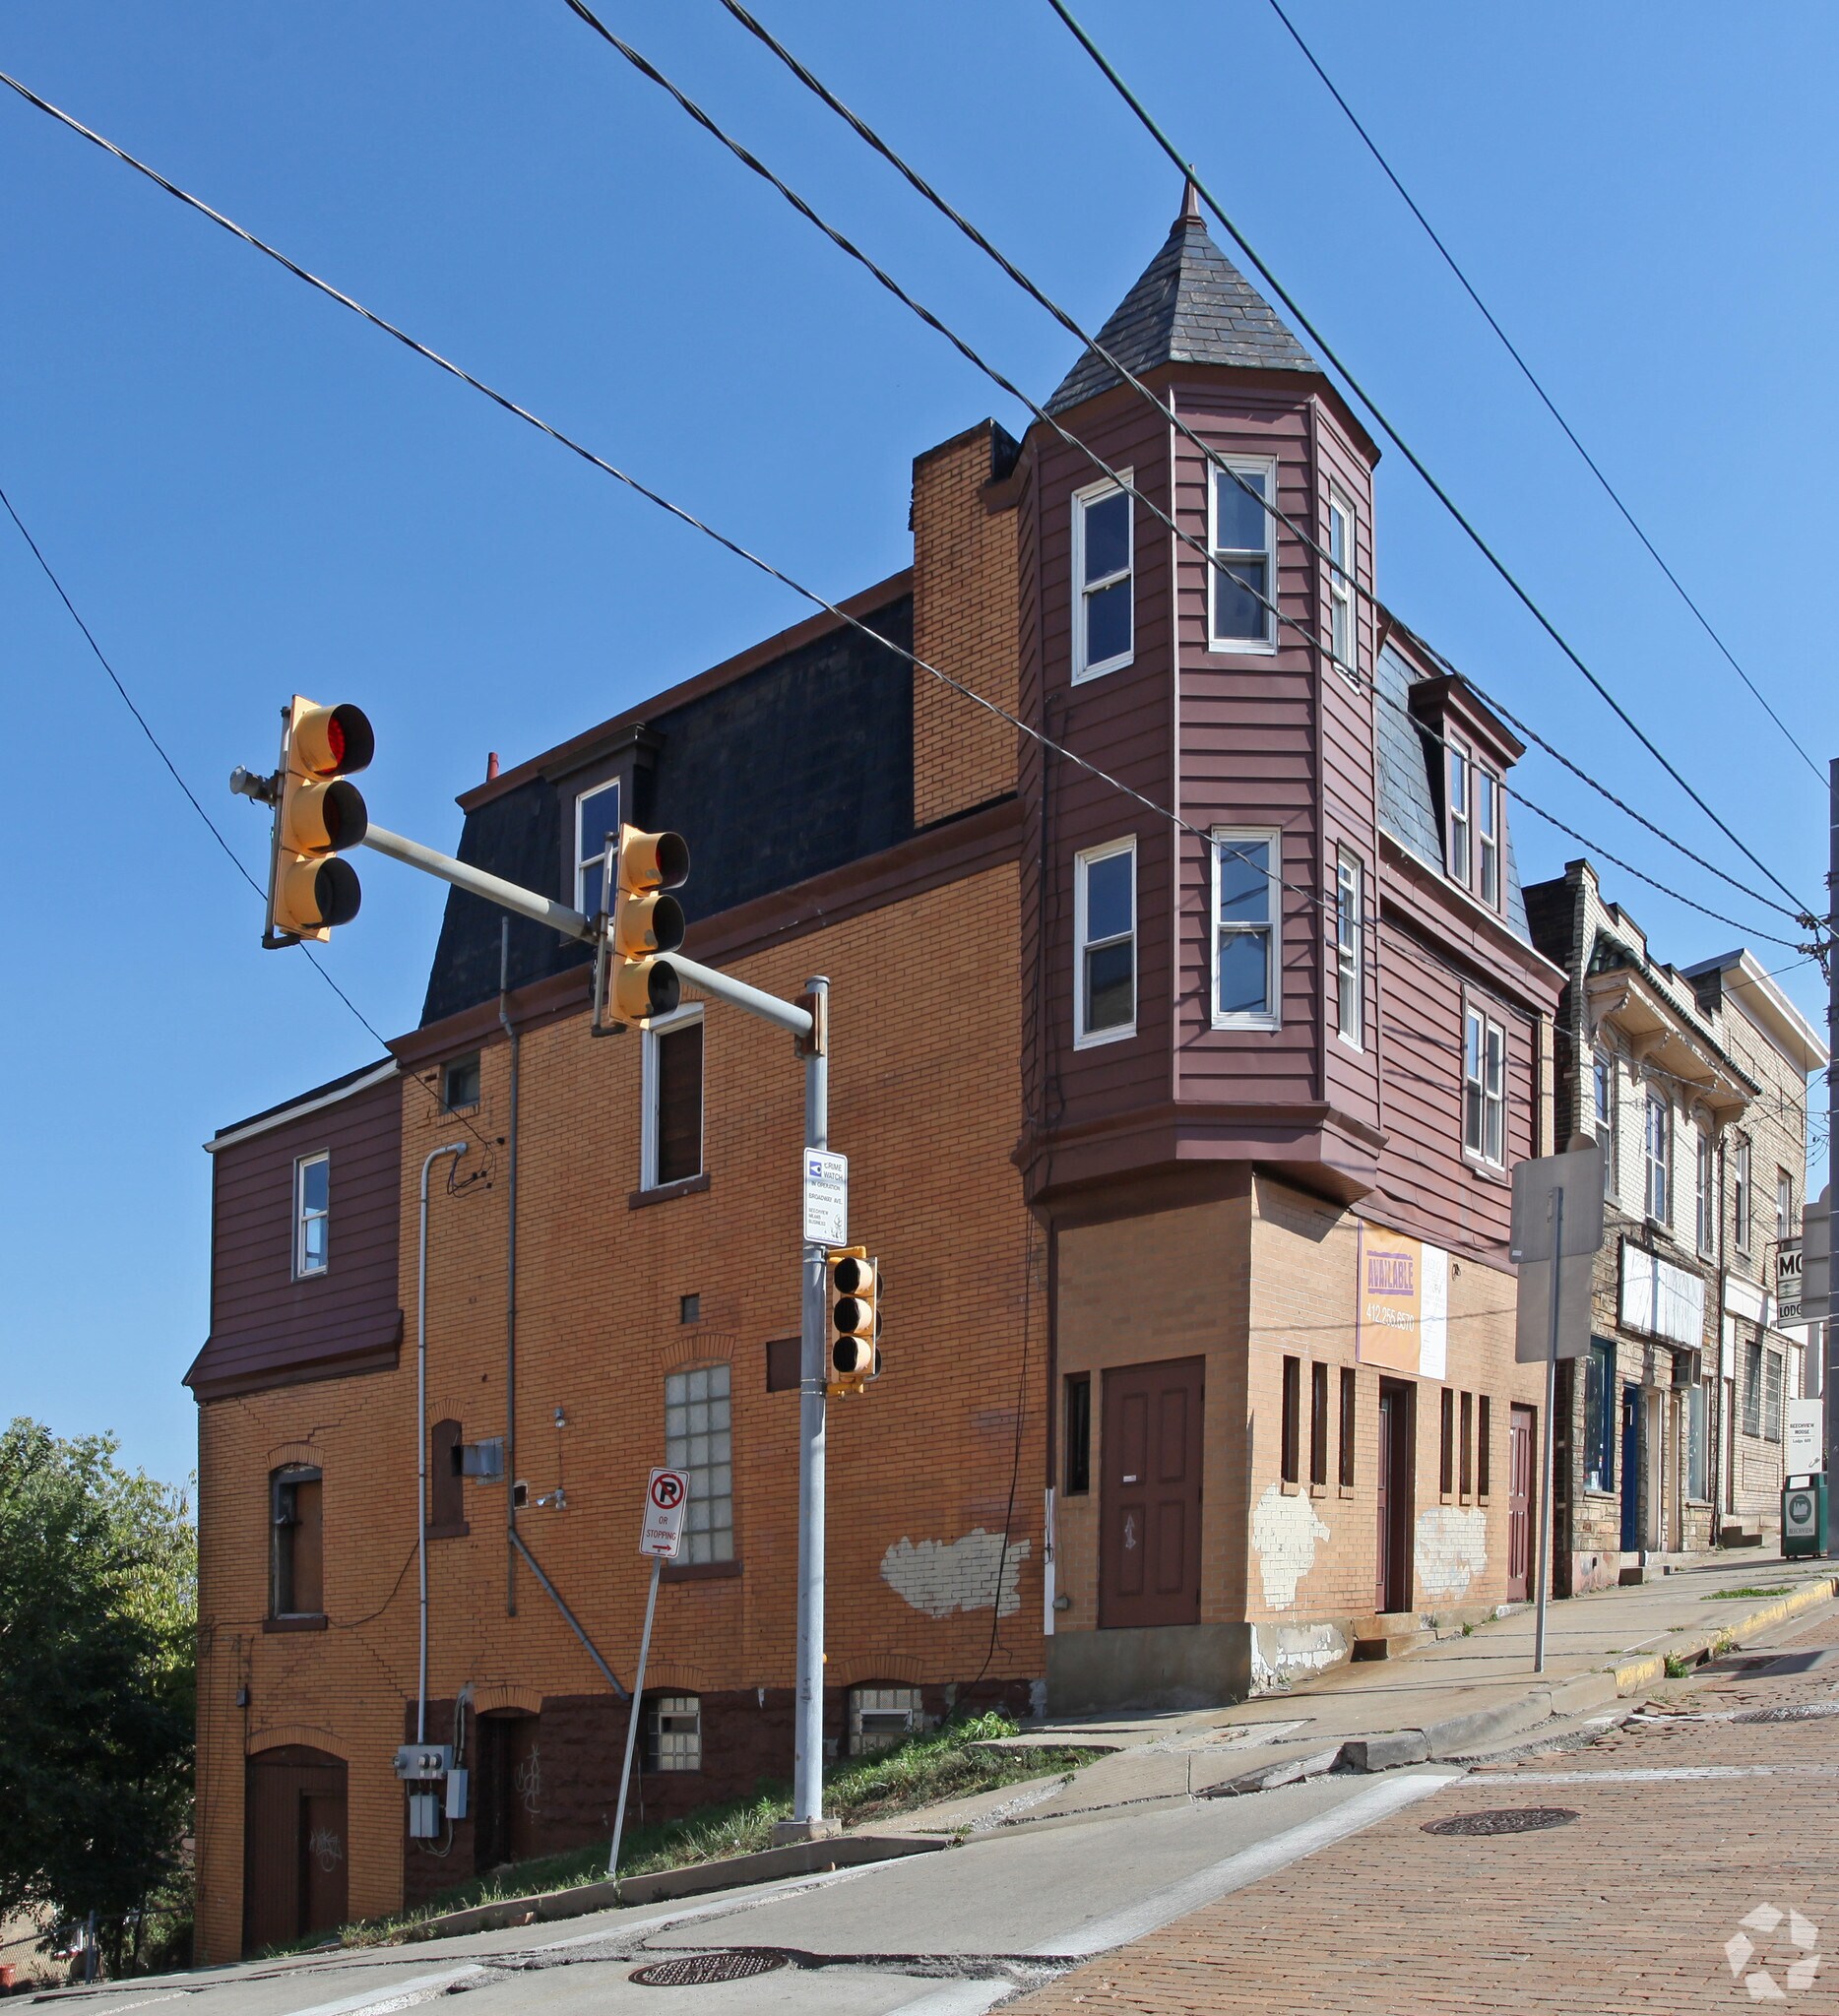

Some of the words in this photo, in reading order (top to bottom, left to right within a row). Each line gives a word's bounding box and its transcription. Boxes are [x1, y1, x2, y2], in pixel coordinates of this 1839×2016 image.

[824, 1163, 842, 1171] CRIME
[824, 1171, 843, 1181] WATCH
[817, 1182, 840, 1191] OPERATION
[808, 1193, 832, 1202] BROADWAY
[1368, 1259, 1414, 1289] AVAILABLE
[1366, 1302, 1415, 1333] 412.255.6570
[659, 1516, 668, 1525] OR
[646, 1529, 676, 1541] STOPPING
